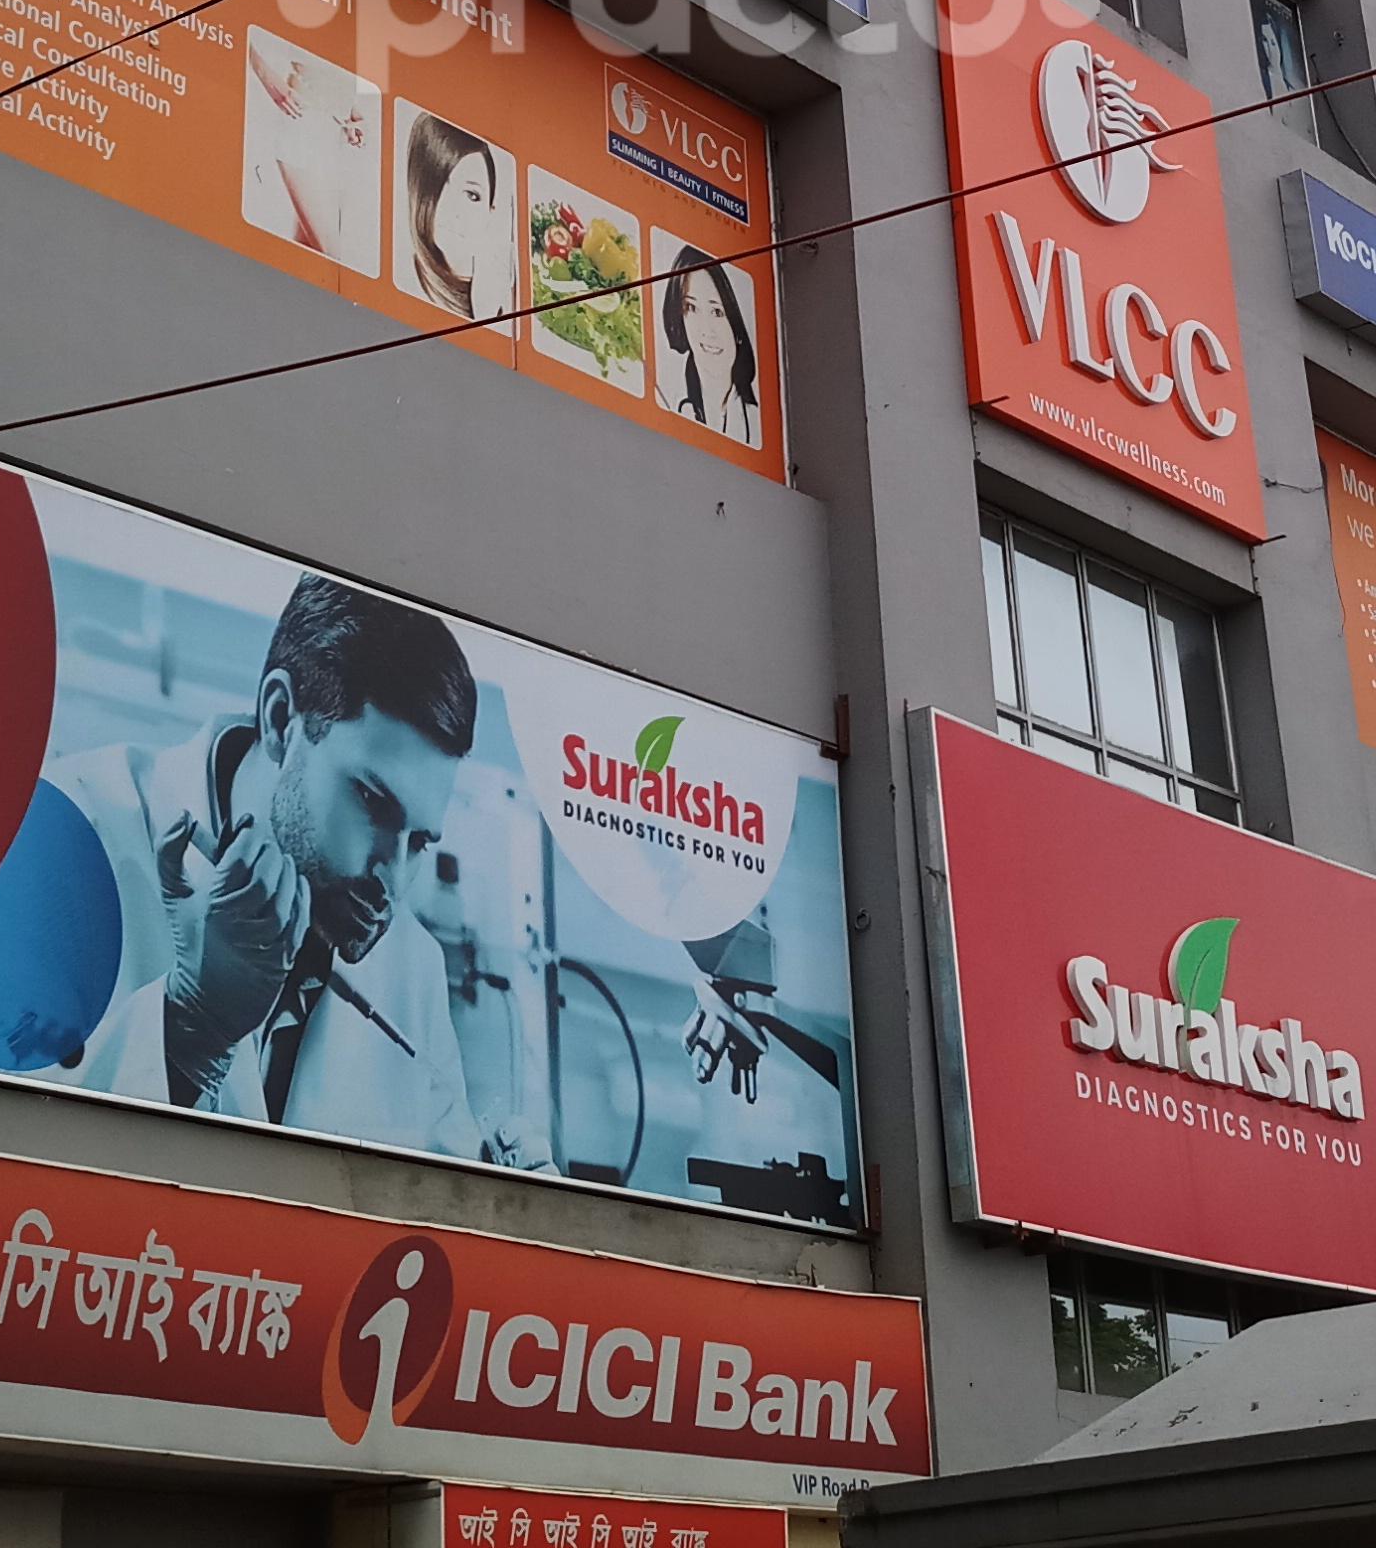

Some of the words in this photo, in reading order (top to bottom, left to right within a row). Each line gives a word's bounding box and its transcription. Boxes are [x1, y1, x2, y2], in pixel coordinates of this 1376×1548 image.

[21, 65, 109, 125] Activity
[32, 37, 172, 117] Consultation
[68, 20, 187, 97] Counseling
[28, 102, 117, 161] Activity
[660, 108, 743, 183] VLCC
[611, 138, 658, 171] SLIMMING
[667, 167, 702, 193] BEAUTY
[712, 190, 745, 217] FITNESS
[992, 209, 1238, 440] VLCC
[1029, 392, 1226, 506] www.vlccwellness.com
[1347, 514, 1375, 544] we
[562, 733, 764, 845] Suraksha
[563, 800, 686, 851] DIAGNOSTICS
[692, 839, 725, 864] FOR
[731, 850, 765, 874] YOU
[1066, 955, 1365, 1121] Suraksha
[1076, 1070, 1252, 1140] DIAGNOSTICS
[1261, 1120, 1308, 1156] FOR
[1315, 1133, 1363, 1167] YOU
[73, 1227, 184, 1362] আই
[453, 1308, 681, 1424] ICICI
[696, 1341, 898, 1448] Bank
[792, 1472, 818, 1495] VIP
[822, 1476, 857, 1498] Road
